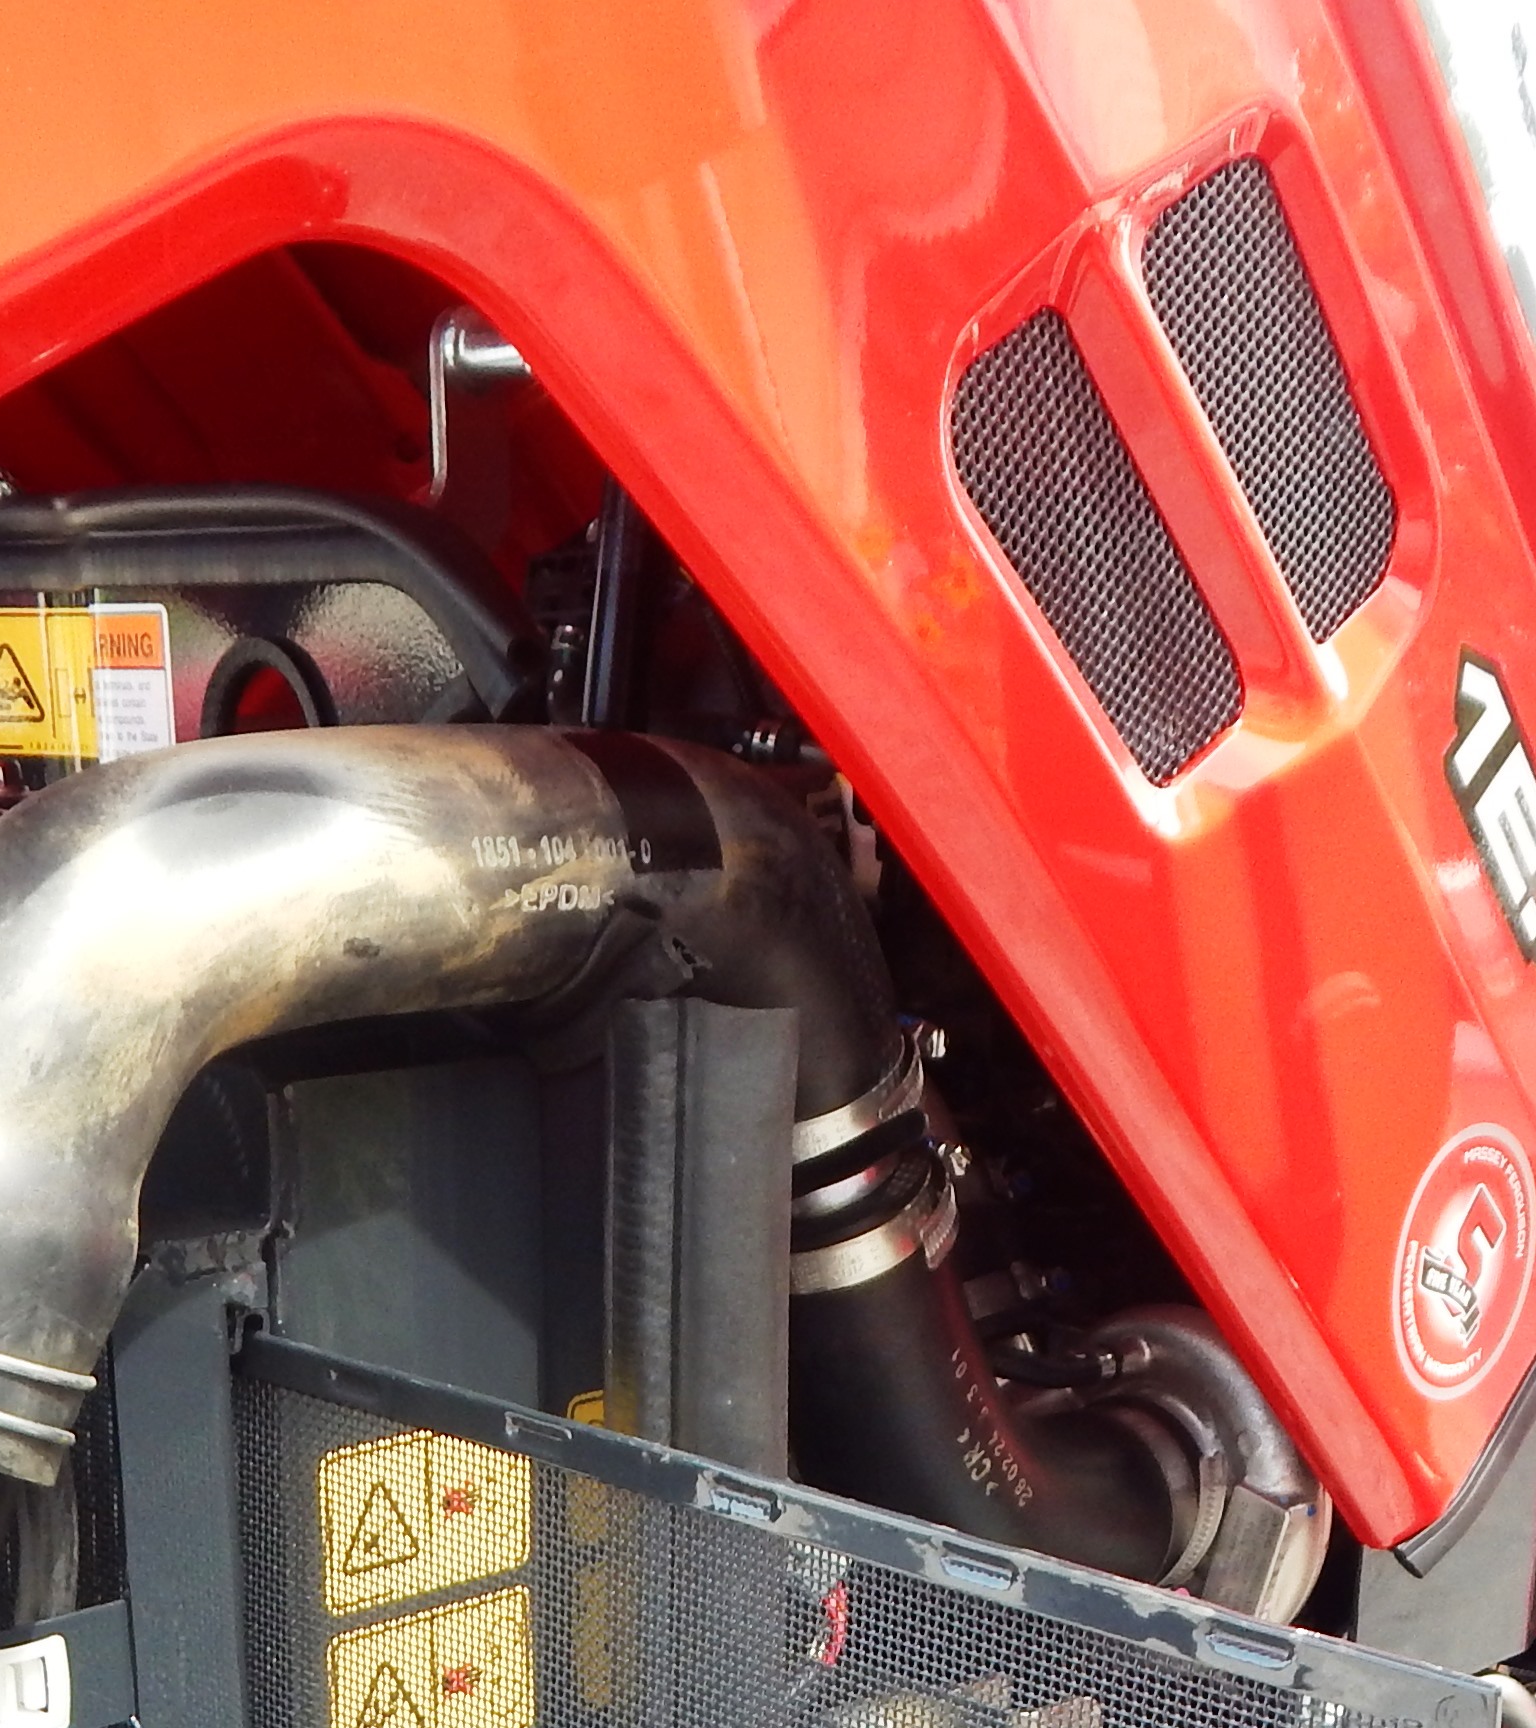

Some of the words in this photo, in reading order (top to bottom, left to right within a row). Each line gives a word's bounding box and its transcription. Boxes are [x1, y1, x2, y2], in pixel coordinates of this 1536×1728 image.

[95, 632, 154, 658] RNING
[1464, 1145, 1508, 1169] MASSEY
[1504, 1163, 1527, 1258] FERGUSON
